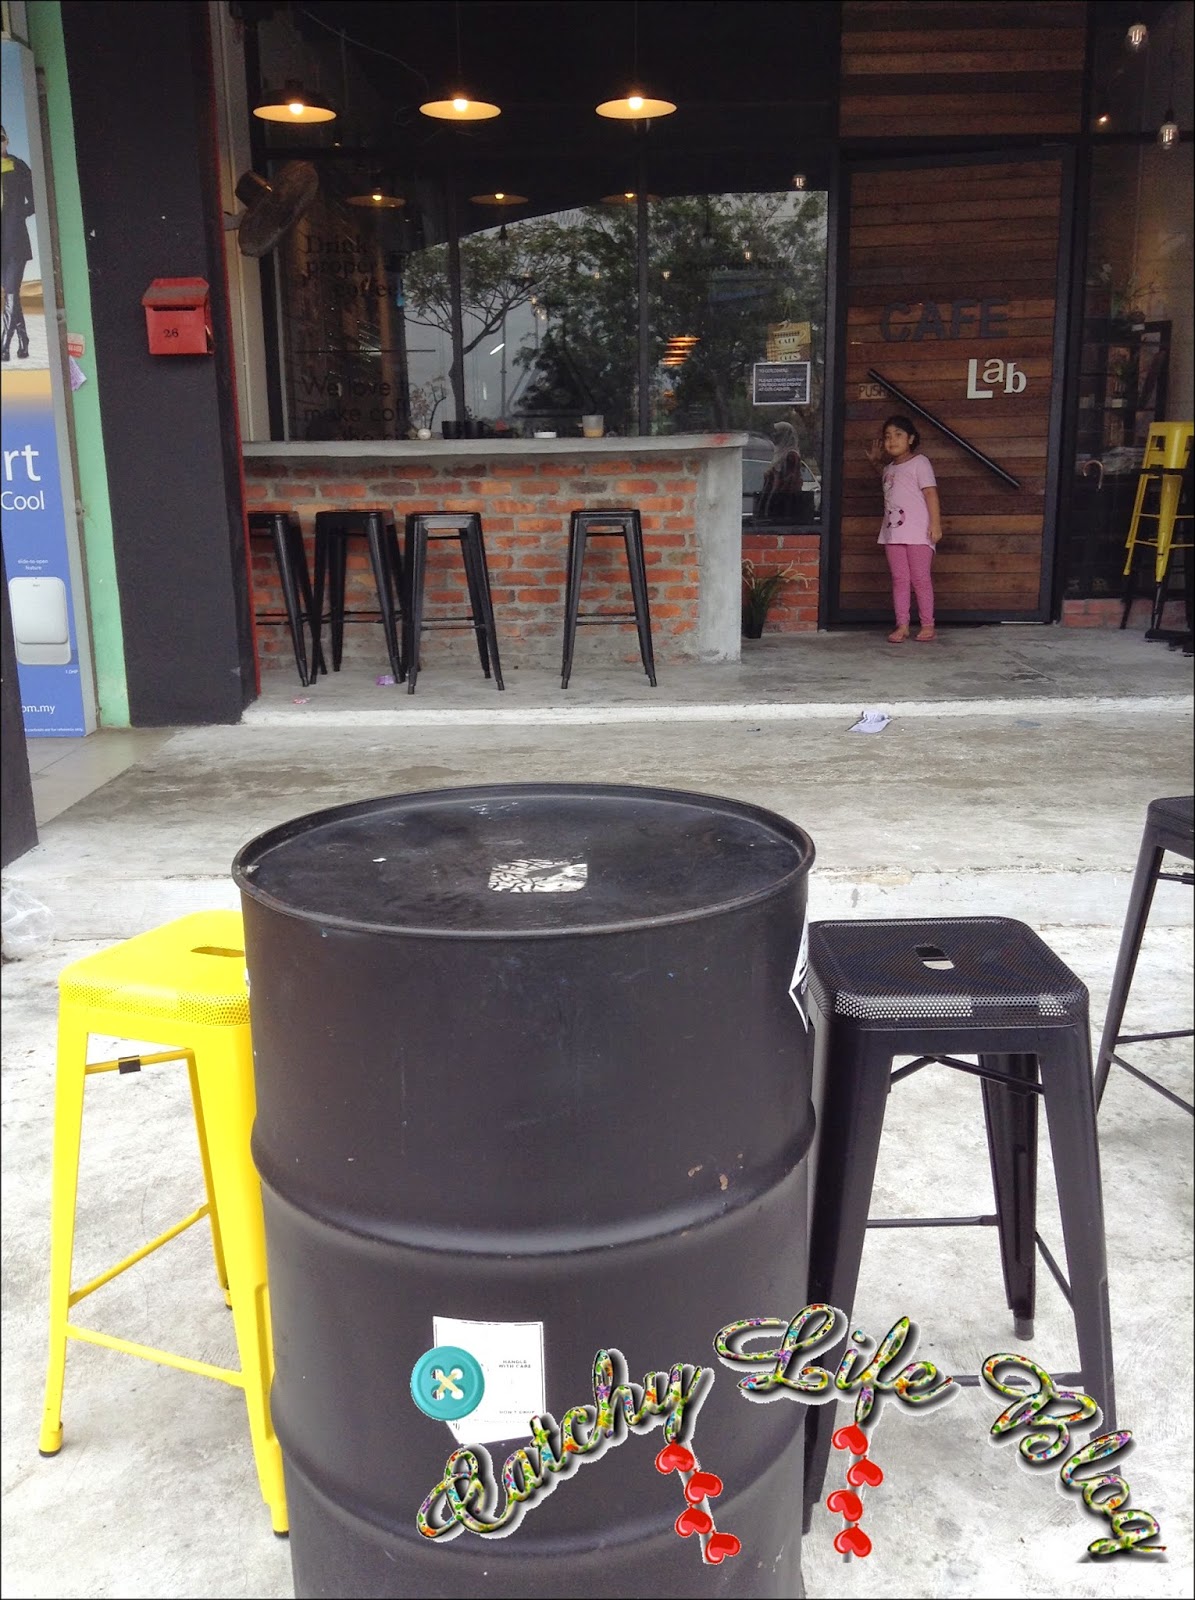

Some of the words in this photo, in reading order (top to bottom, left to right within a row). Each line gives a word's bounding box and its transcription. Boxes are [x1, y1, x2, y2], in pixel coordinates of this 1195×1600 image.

[880, 296, 1009, 342] CAFE
[163, 328, 179, 338] 26
[966, 358, 1027, 399] Lab
[859, 385, 885, 398] PUSH
[1, 490, 45, 510] Cool
